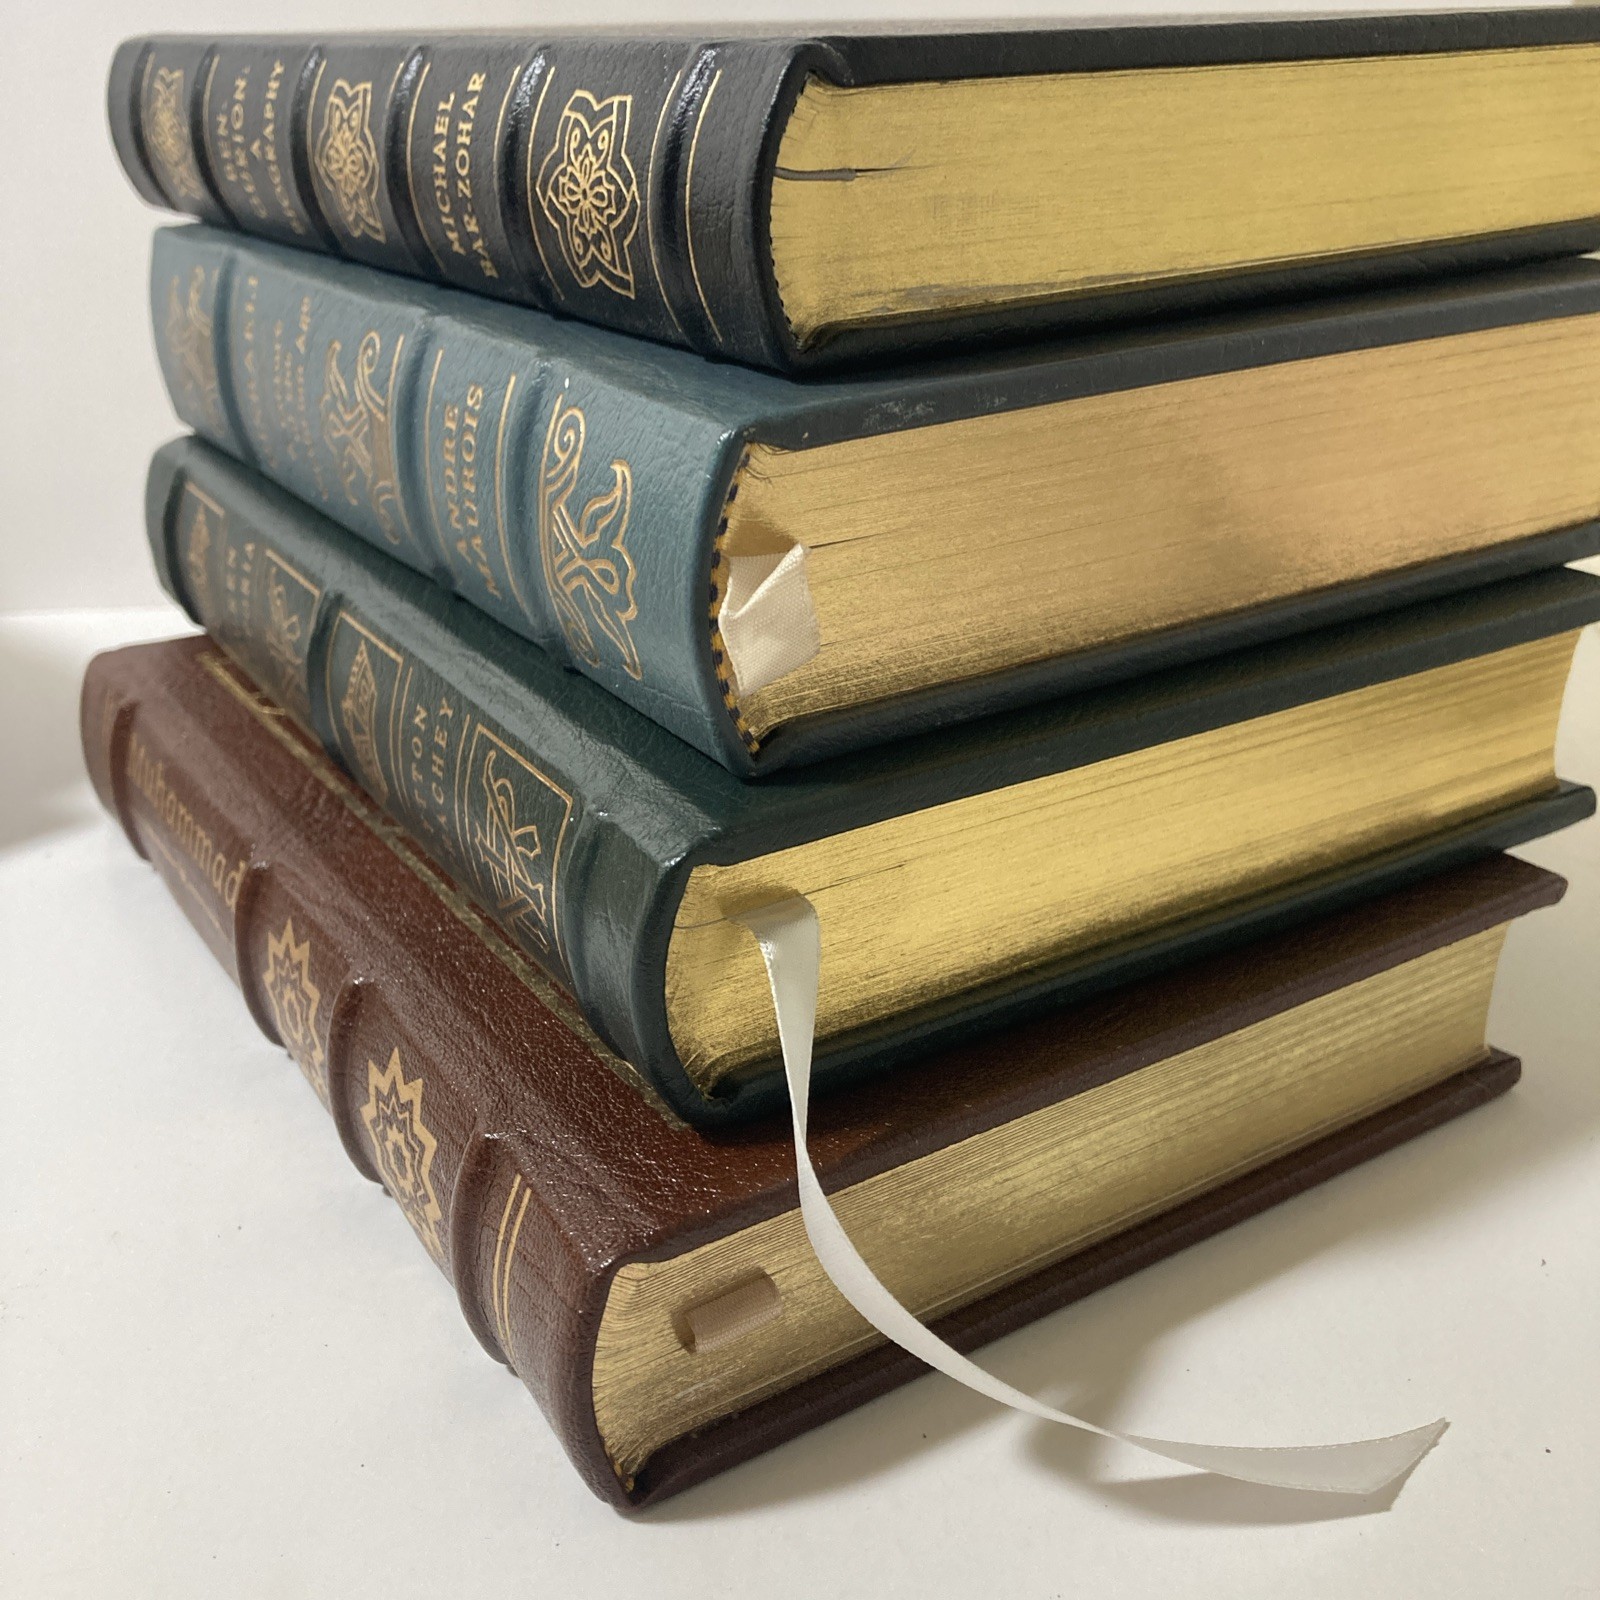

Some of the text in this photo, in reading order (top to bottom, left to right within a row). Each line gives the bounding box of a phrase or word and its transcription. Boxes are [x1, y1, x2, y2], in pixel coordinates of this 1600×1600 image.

[250, 138, 261, 161] A
[432, 90, 468, 256] MICHAEL
[455, 72, 500, 279] BAR-ZOHAR
[442, 402, 472, 565] ANDRE
[461, 383, 504, 600] MAUROIS
[127, 732, 246, 911] Muhammad
